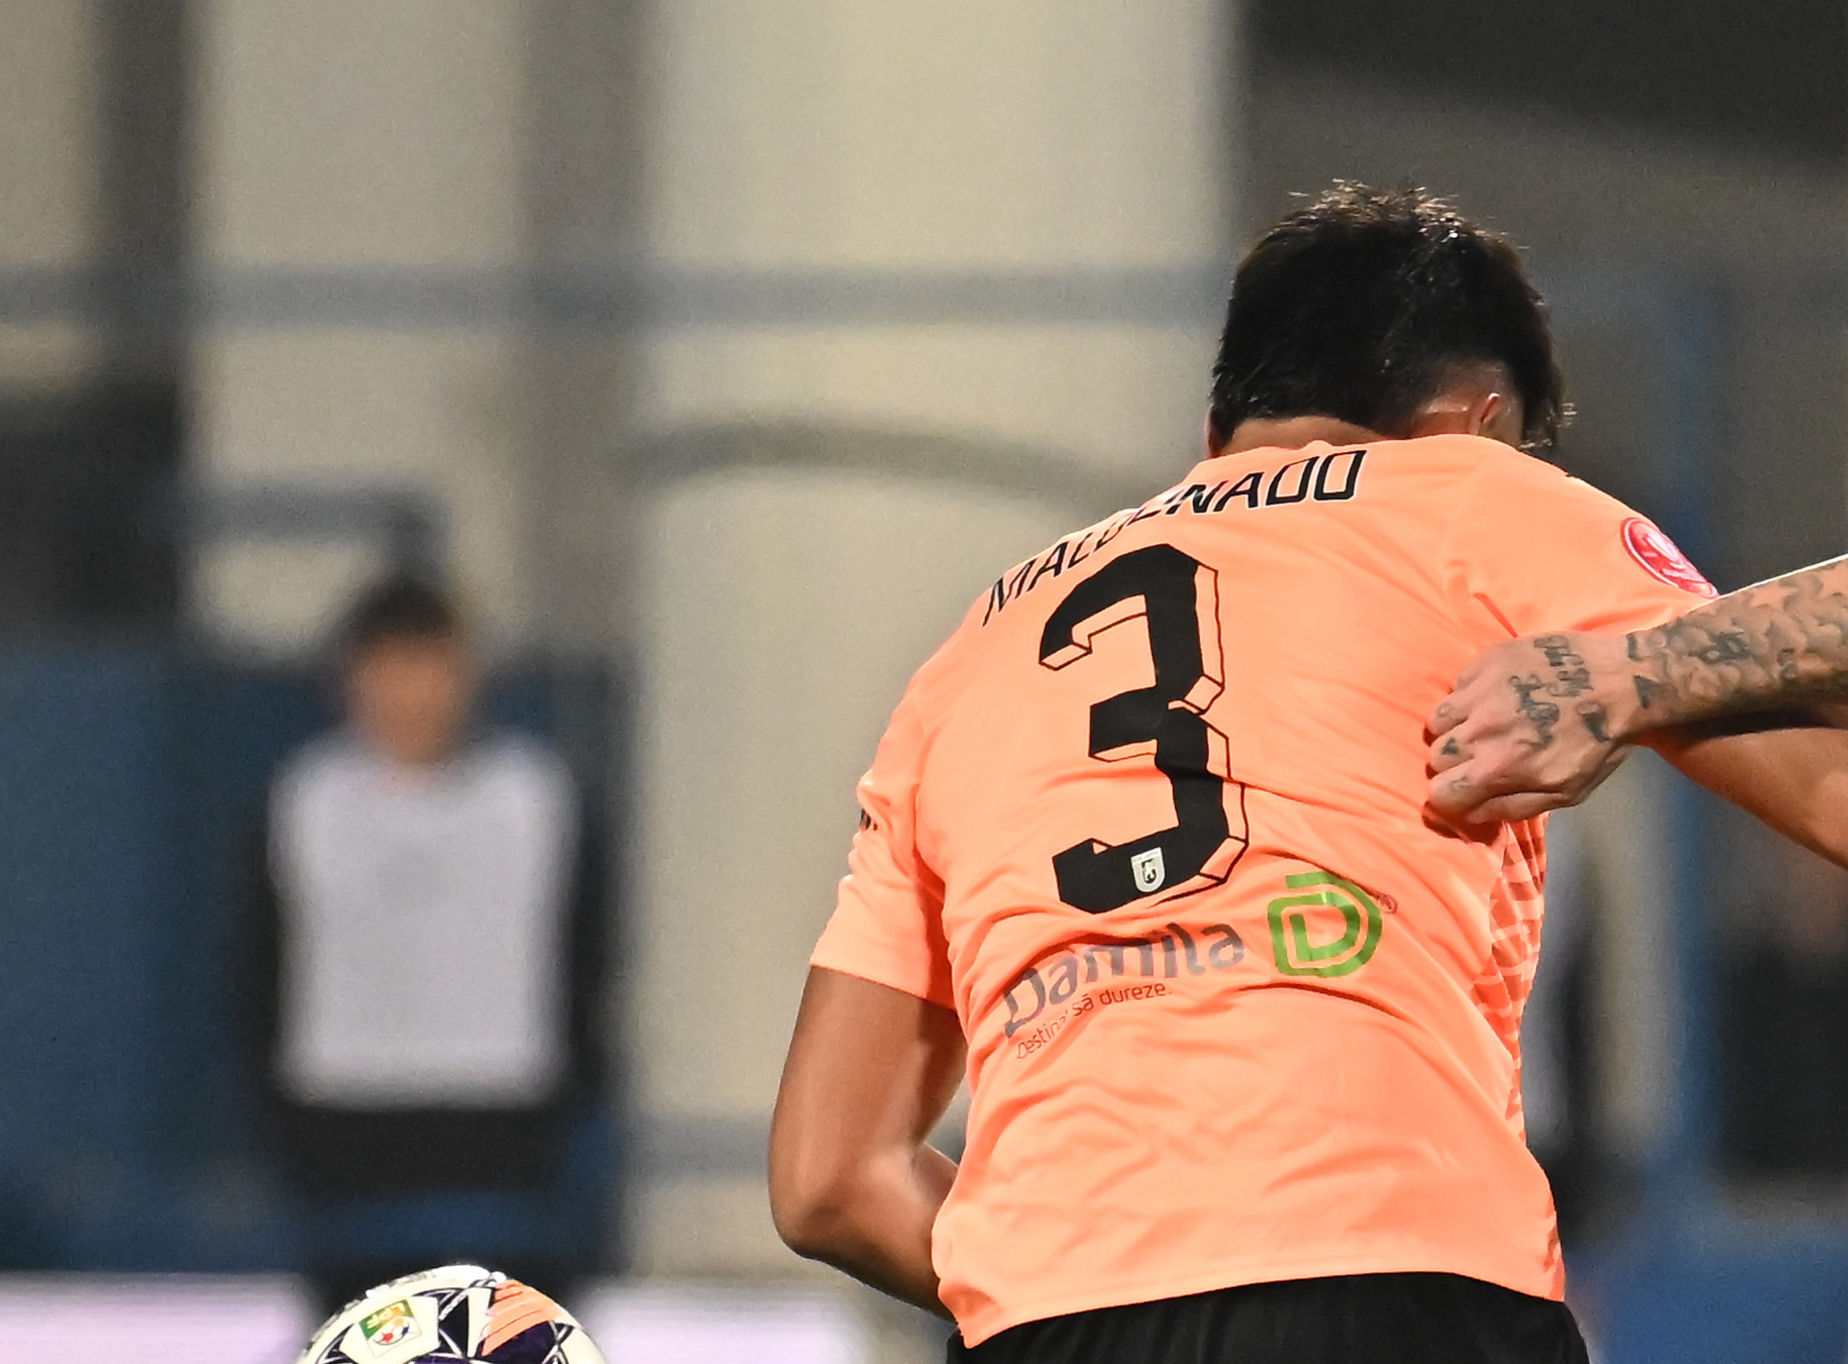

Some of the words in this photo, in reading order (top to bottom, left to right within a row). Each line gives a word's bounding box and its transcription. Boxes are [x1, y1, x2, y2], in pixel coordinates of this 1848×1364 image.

[1038, 543, 1249, 914] 3
[1004, 922, 1246, 1039] Damila
[1099, 982, 1173, 1006] dureze.
[365, 1302, 406, 1329] LPF
